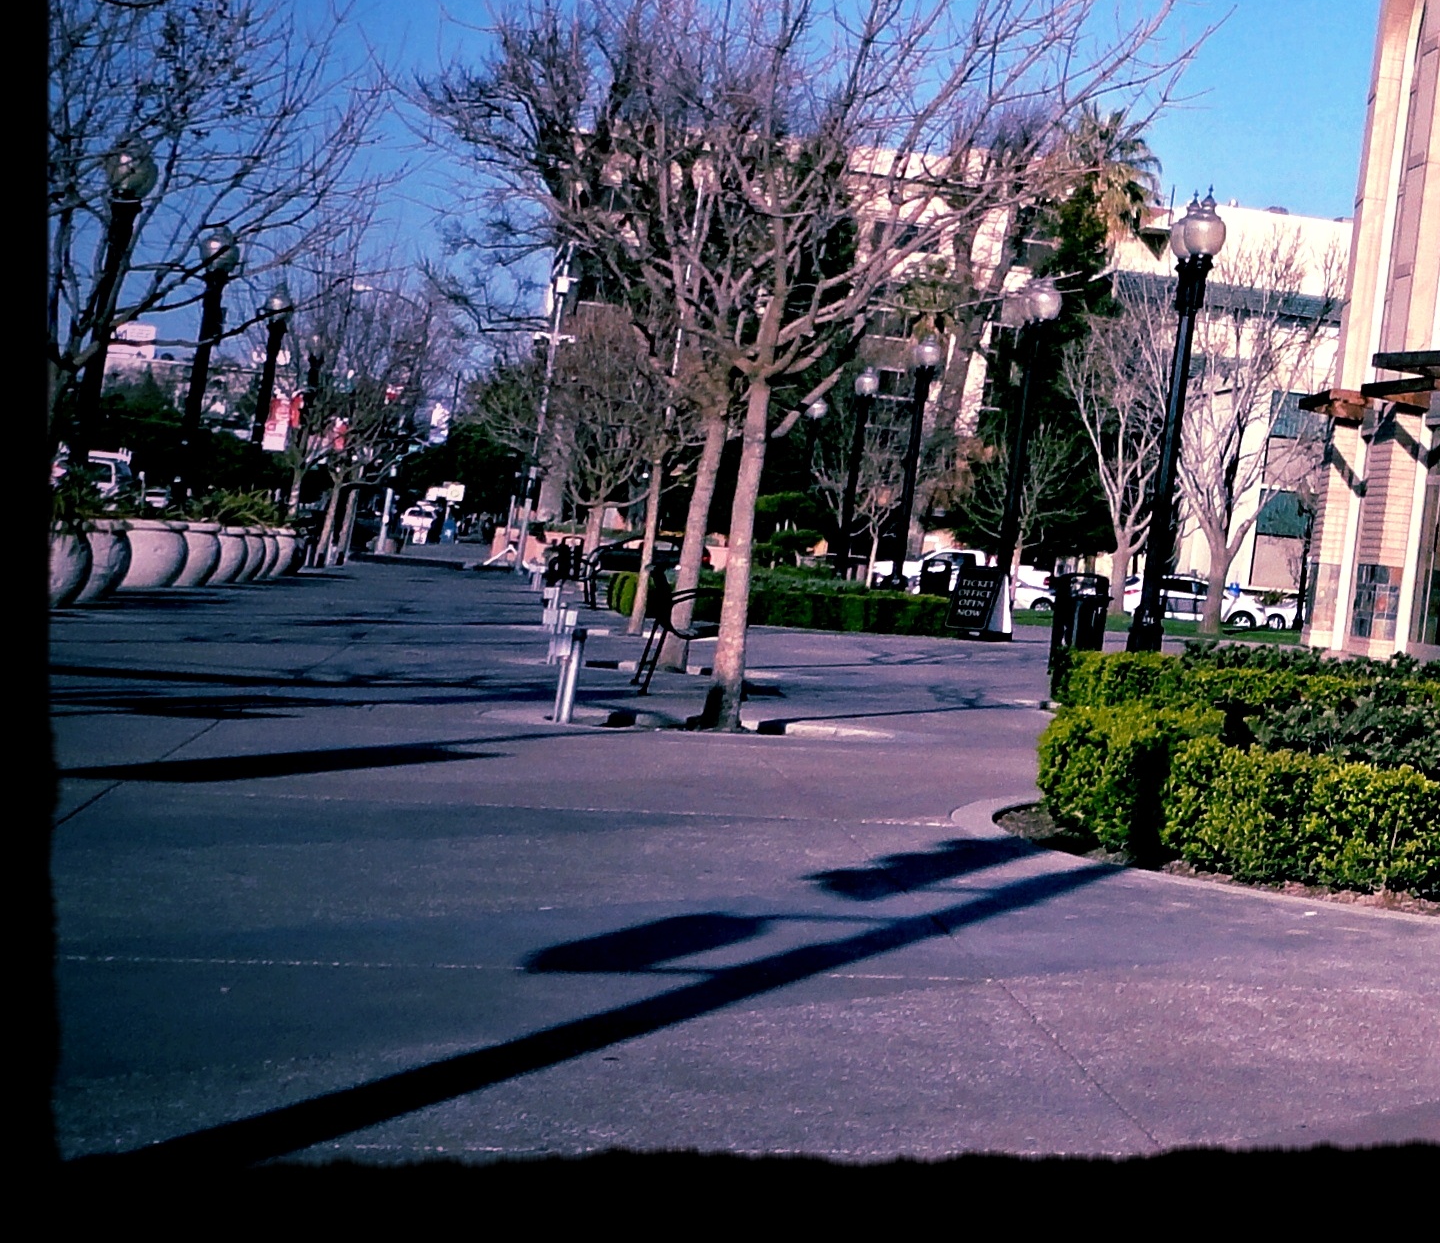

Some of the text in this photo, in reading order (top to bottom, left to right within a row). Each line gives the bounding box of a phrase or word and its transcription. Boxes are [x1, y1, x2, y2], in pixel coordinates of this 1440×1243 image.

[962, 579, 994, 588] TICKET
[958, 589, 991, 598] OFFICE
[958, 598, 985, 607] OPEN
[956, 608, 981, 617] NOW
